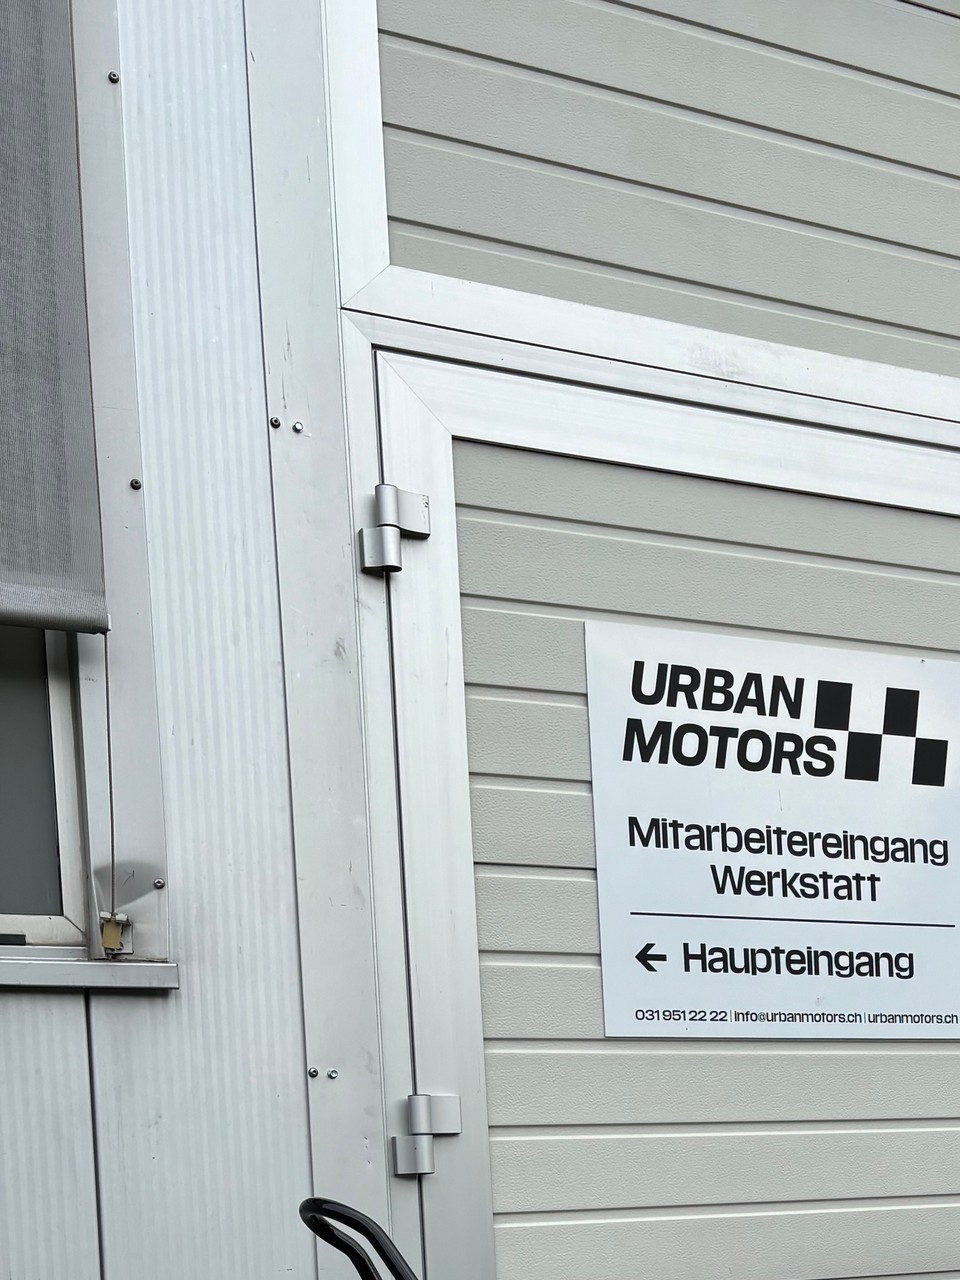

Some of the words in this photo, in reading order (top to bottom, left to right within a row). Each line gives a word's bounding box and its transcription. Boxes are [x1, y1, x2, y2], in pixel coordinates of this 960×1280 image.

[631, 660, 805, 720] URBAN
[622, 717, 837, 778] MOTORS
[628, 816, 949, 867] Mitarbeitereingang
[709, 864, 881, 902] Werkstatt
[682, 942, 915, 980] Haupteingang
[635, 1009, 660, 1022] 031
[662, 1009, 687, 1022] 951
[688, 1010, 707, 1022] 22
[709, 1010, 728, 1022] 22
[867, 1012, 959, 1025] urbanmotors.ch
